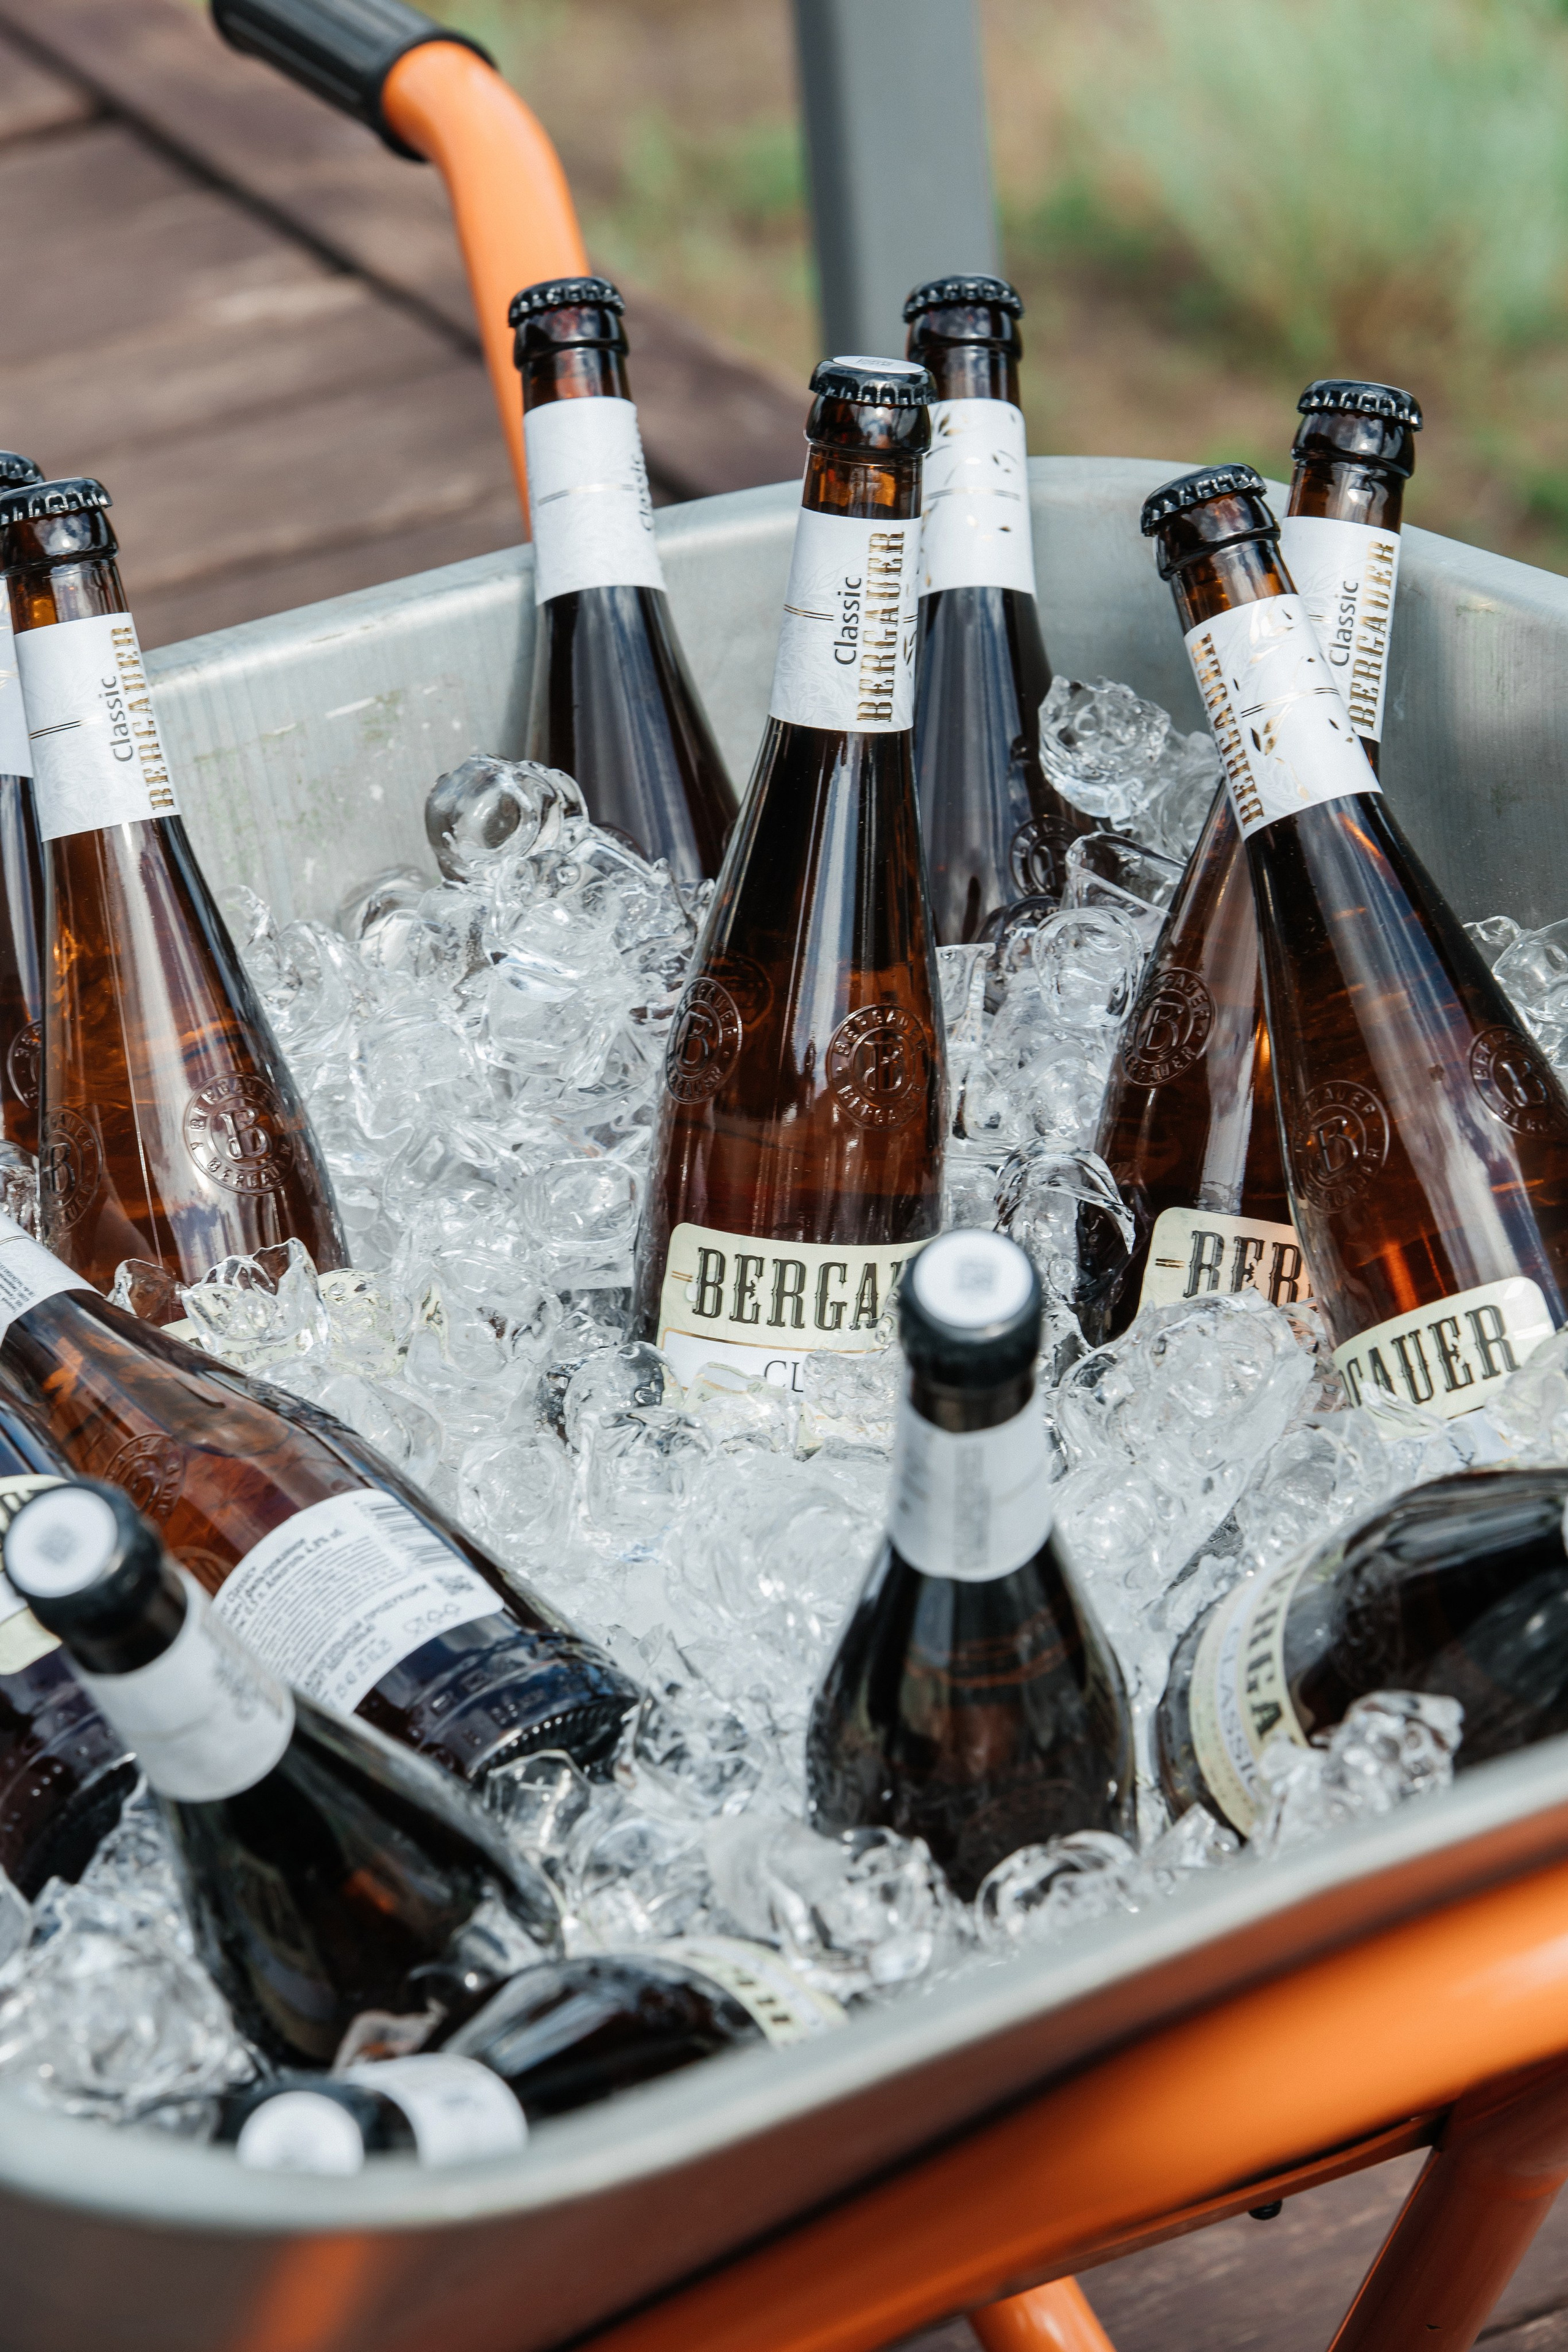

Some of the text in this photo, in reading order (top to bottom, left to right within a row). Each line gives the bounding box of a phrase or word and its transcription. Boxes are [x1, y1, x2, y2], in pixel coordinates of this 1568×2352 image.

[834, 576, 862, 665] Classic
[857, 531, 905, 722] BERGAUER
[1329, 581, 1359, 666] Classic
[1348, 541, 1395, 730] BERGAUER
[99, 676, 134, 761] Classic
[111, 626, 175, 810] BERGAUER
[1191, 633, 1264, 829] BERGAUER
[692, 1246, 904, 1331] BERGA
[1183, 1231, 1314, 1307] BER
